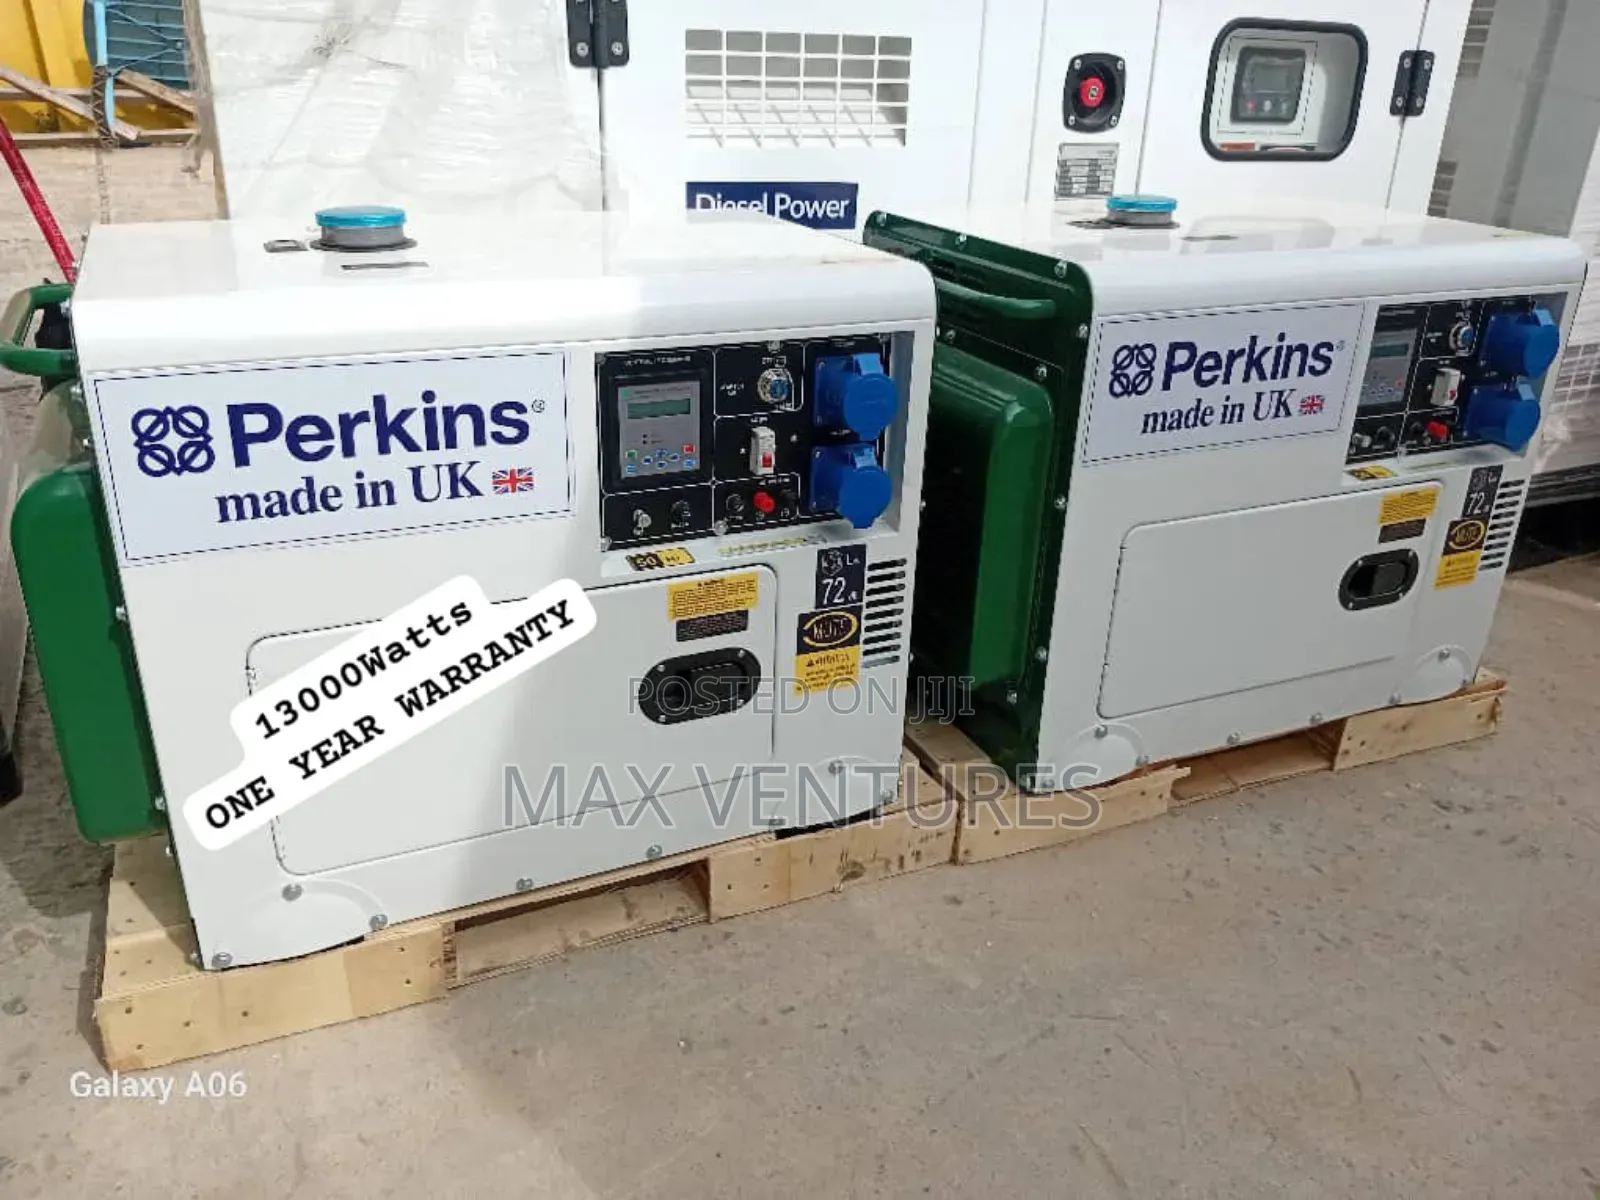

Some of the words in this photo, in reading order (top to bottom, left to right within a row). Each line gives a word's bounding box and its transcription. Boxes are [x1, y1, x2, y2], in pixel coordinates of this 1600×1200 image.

[774, 192, 850, 219] Power
[1161, 332, 1334, 391] Perkins
[227, 390, 530, 468] Perkins
[1140, 398, 1215, 434] made
[1219, 395, 1244, 424] in
[1253, 388, 1296, 421] UK
[214, 476, 343, 523] made
[354, 471, 396, 510] in
[407, 460, 483, 502] UK
[1465, 492, 1485, 515] 72
[821, 577, 846, 605] 72
